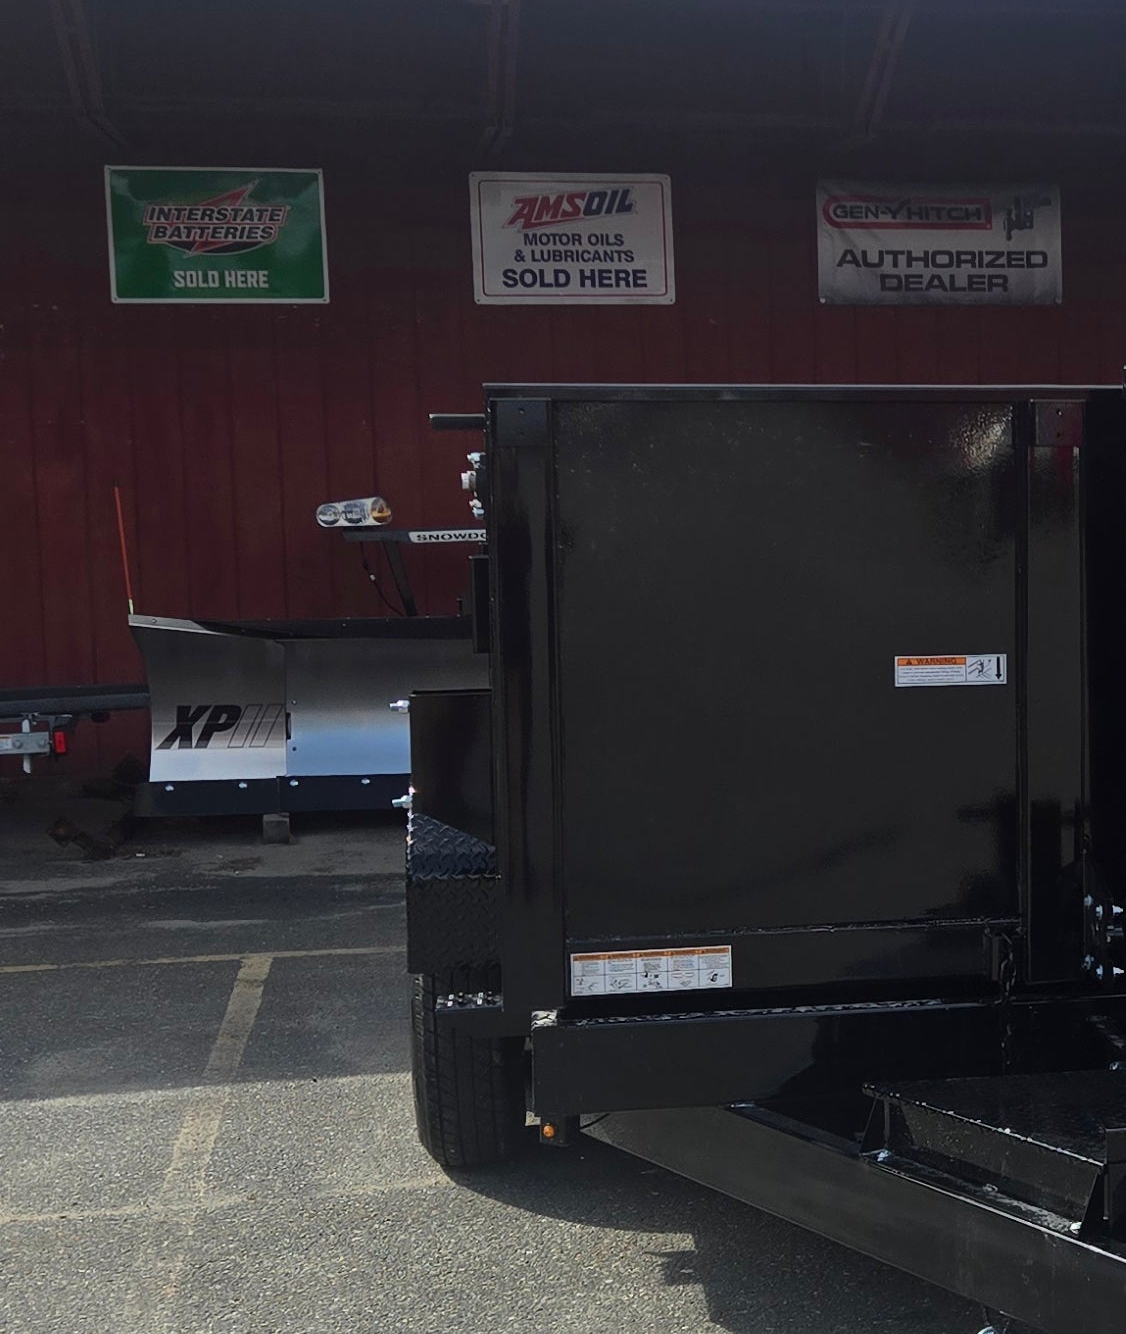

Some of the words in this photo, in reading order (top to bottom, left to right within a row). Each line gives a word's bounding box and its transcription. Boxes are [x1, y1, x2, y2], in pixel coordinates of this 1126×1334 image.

[147, 206, 284, 223] INTERSTATE
[506, 188, 636, 230] AMSOIL
[832, 200, 911, 220] GEN-Y
[906, 205, 983, 222] HITCH
[153, 225, 276, 241] BATTERIES
[523, 233, 583, 246] MOTOR
[588, 233, 625, 246] OILS
[514, 249, 526, 263] &
[531, 249, 635, 263] LUBRICANTS
[836, 249, 1048, 269] AUTHORIZED
[173, 270, 220, 288] SOLD
[224, 270, 269, 288] HERE
[502, 268, 571, 288] SOLD
[580, 268, 648, 288] HERE
[879, 273, 1009, 293] DEALER
